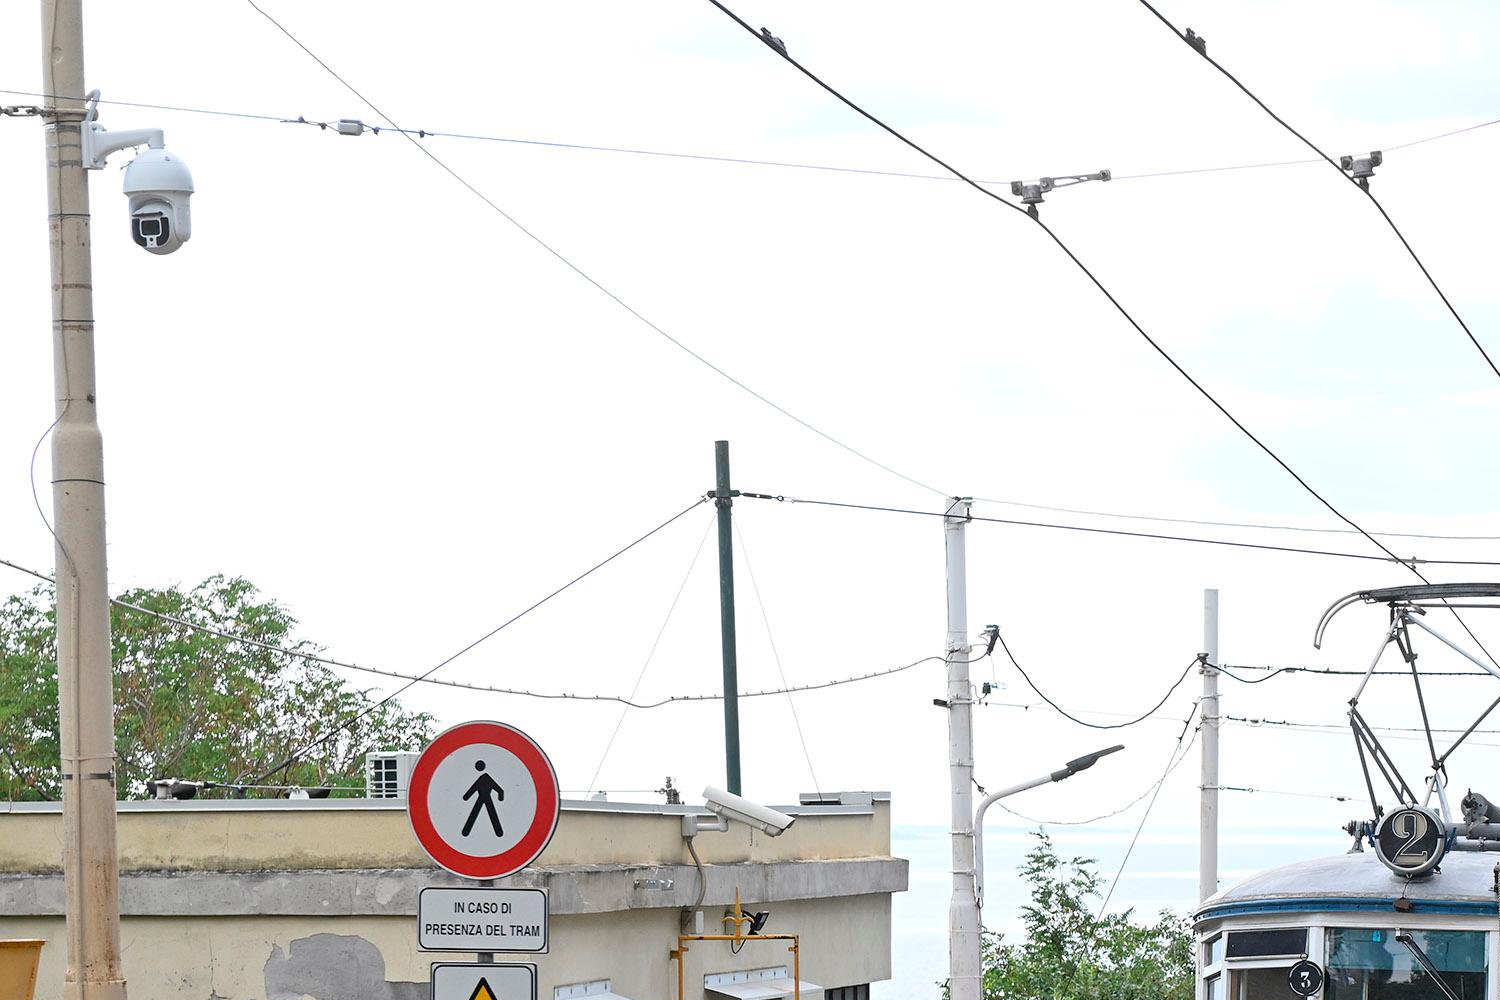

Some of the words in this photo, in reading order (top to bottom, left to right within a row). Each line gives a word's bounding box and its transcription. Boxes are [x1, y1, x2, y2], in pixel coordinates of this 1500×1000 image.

[1392, 810, 1428, 866] 2
[454, 902, 465, 913] IN
[468, 902, 498, 914] CASO
[501, 903, 512, 914] DI
[425, 923, 483, 936] PRESENZA
[486, 924, 507, 936] DEL
[510, 925, 540, 937] TRAM
[1300, 971, 1311, 988] 3
